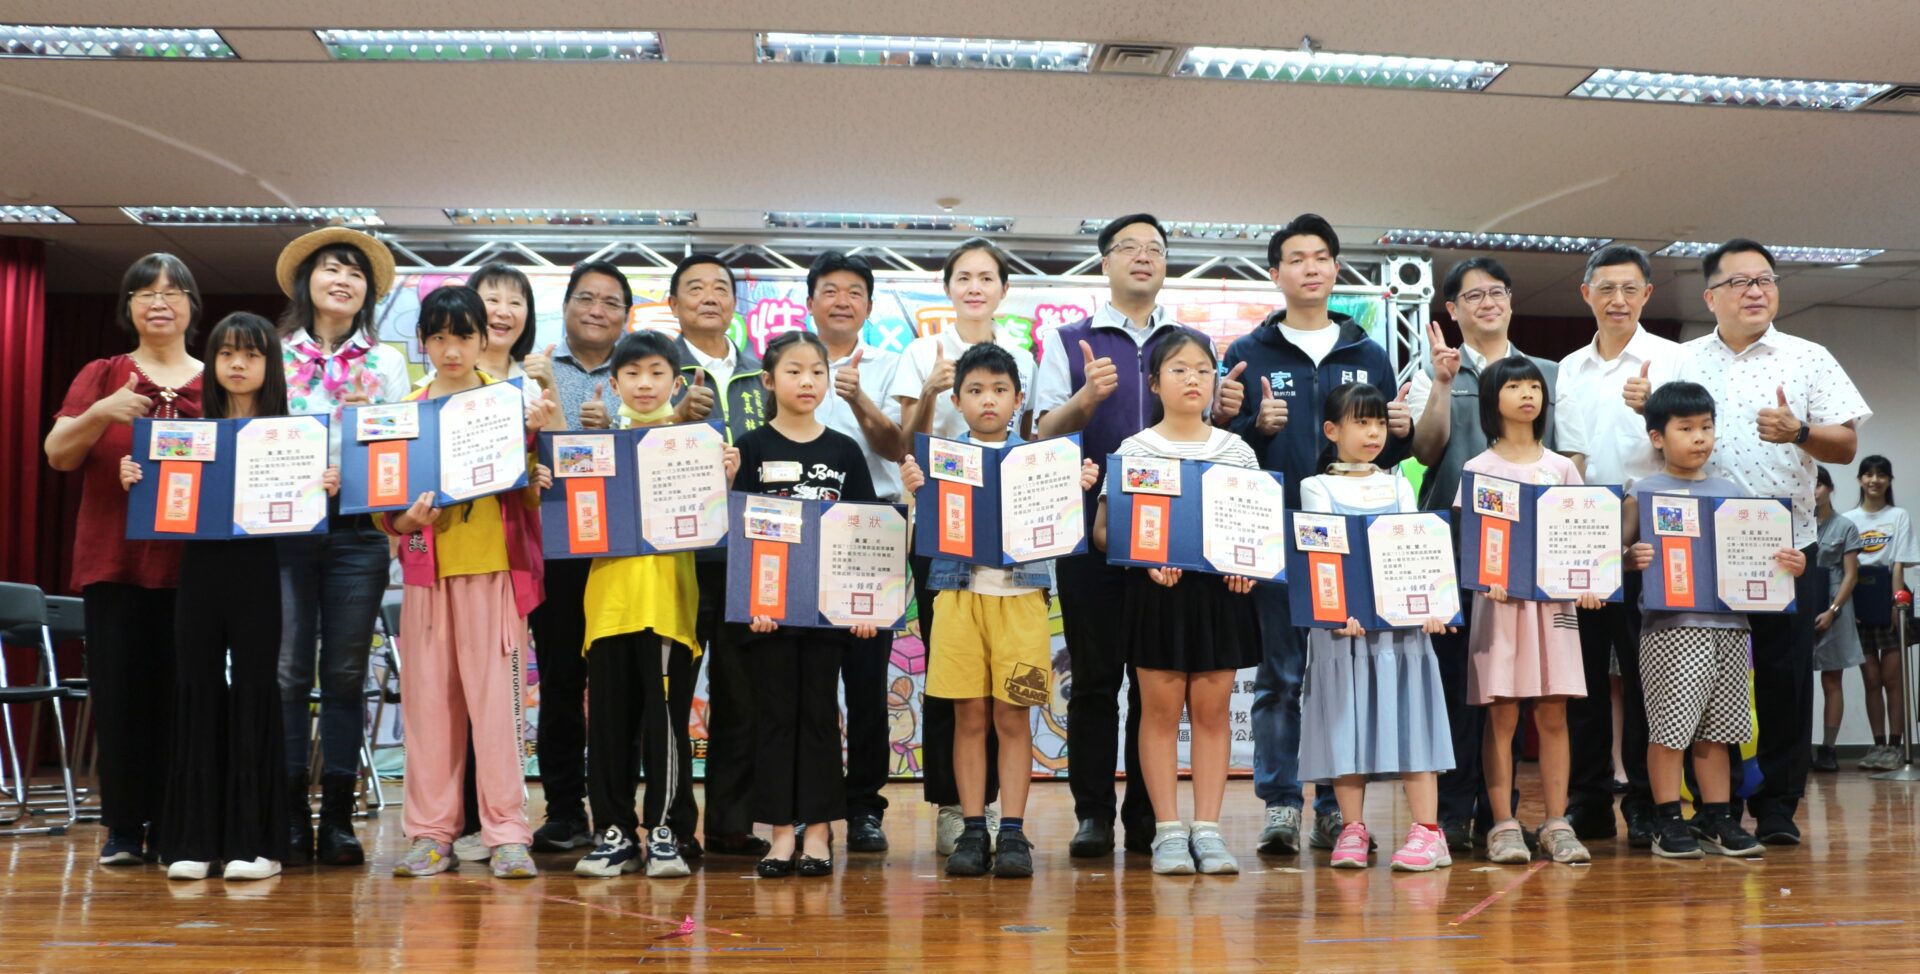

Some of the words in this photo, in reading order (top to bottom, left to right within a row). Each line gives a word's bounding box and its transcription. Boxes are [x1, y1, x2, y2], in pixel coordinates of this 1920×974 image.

[1270, 371, 1292, 390] 家
[663, 436, 699, 451] 獎狀
[1025, 450, 1057, 467] 獎狀
[1562, 497, 1596, 510] 獎狀
[848, 515, 881, 528] 獎狀
[1738, 508, 1769, 521] 獎狀
[1392, 523, 1426, 537] 獎狀
